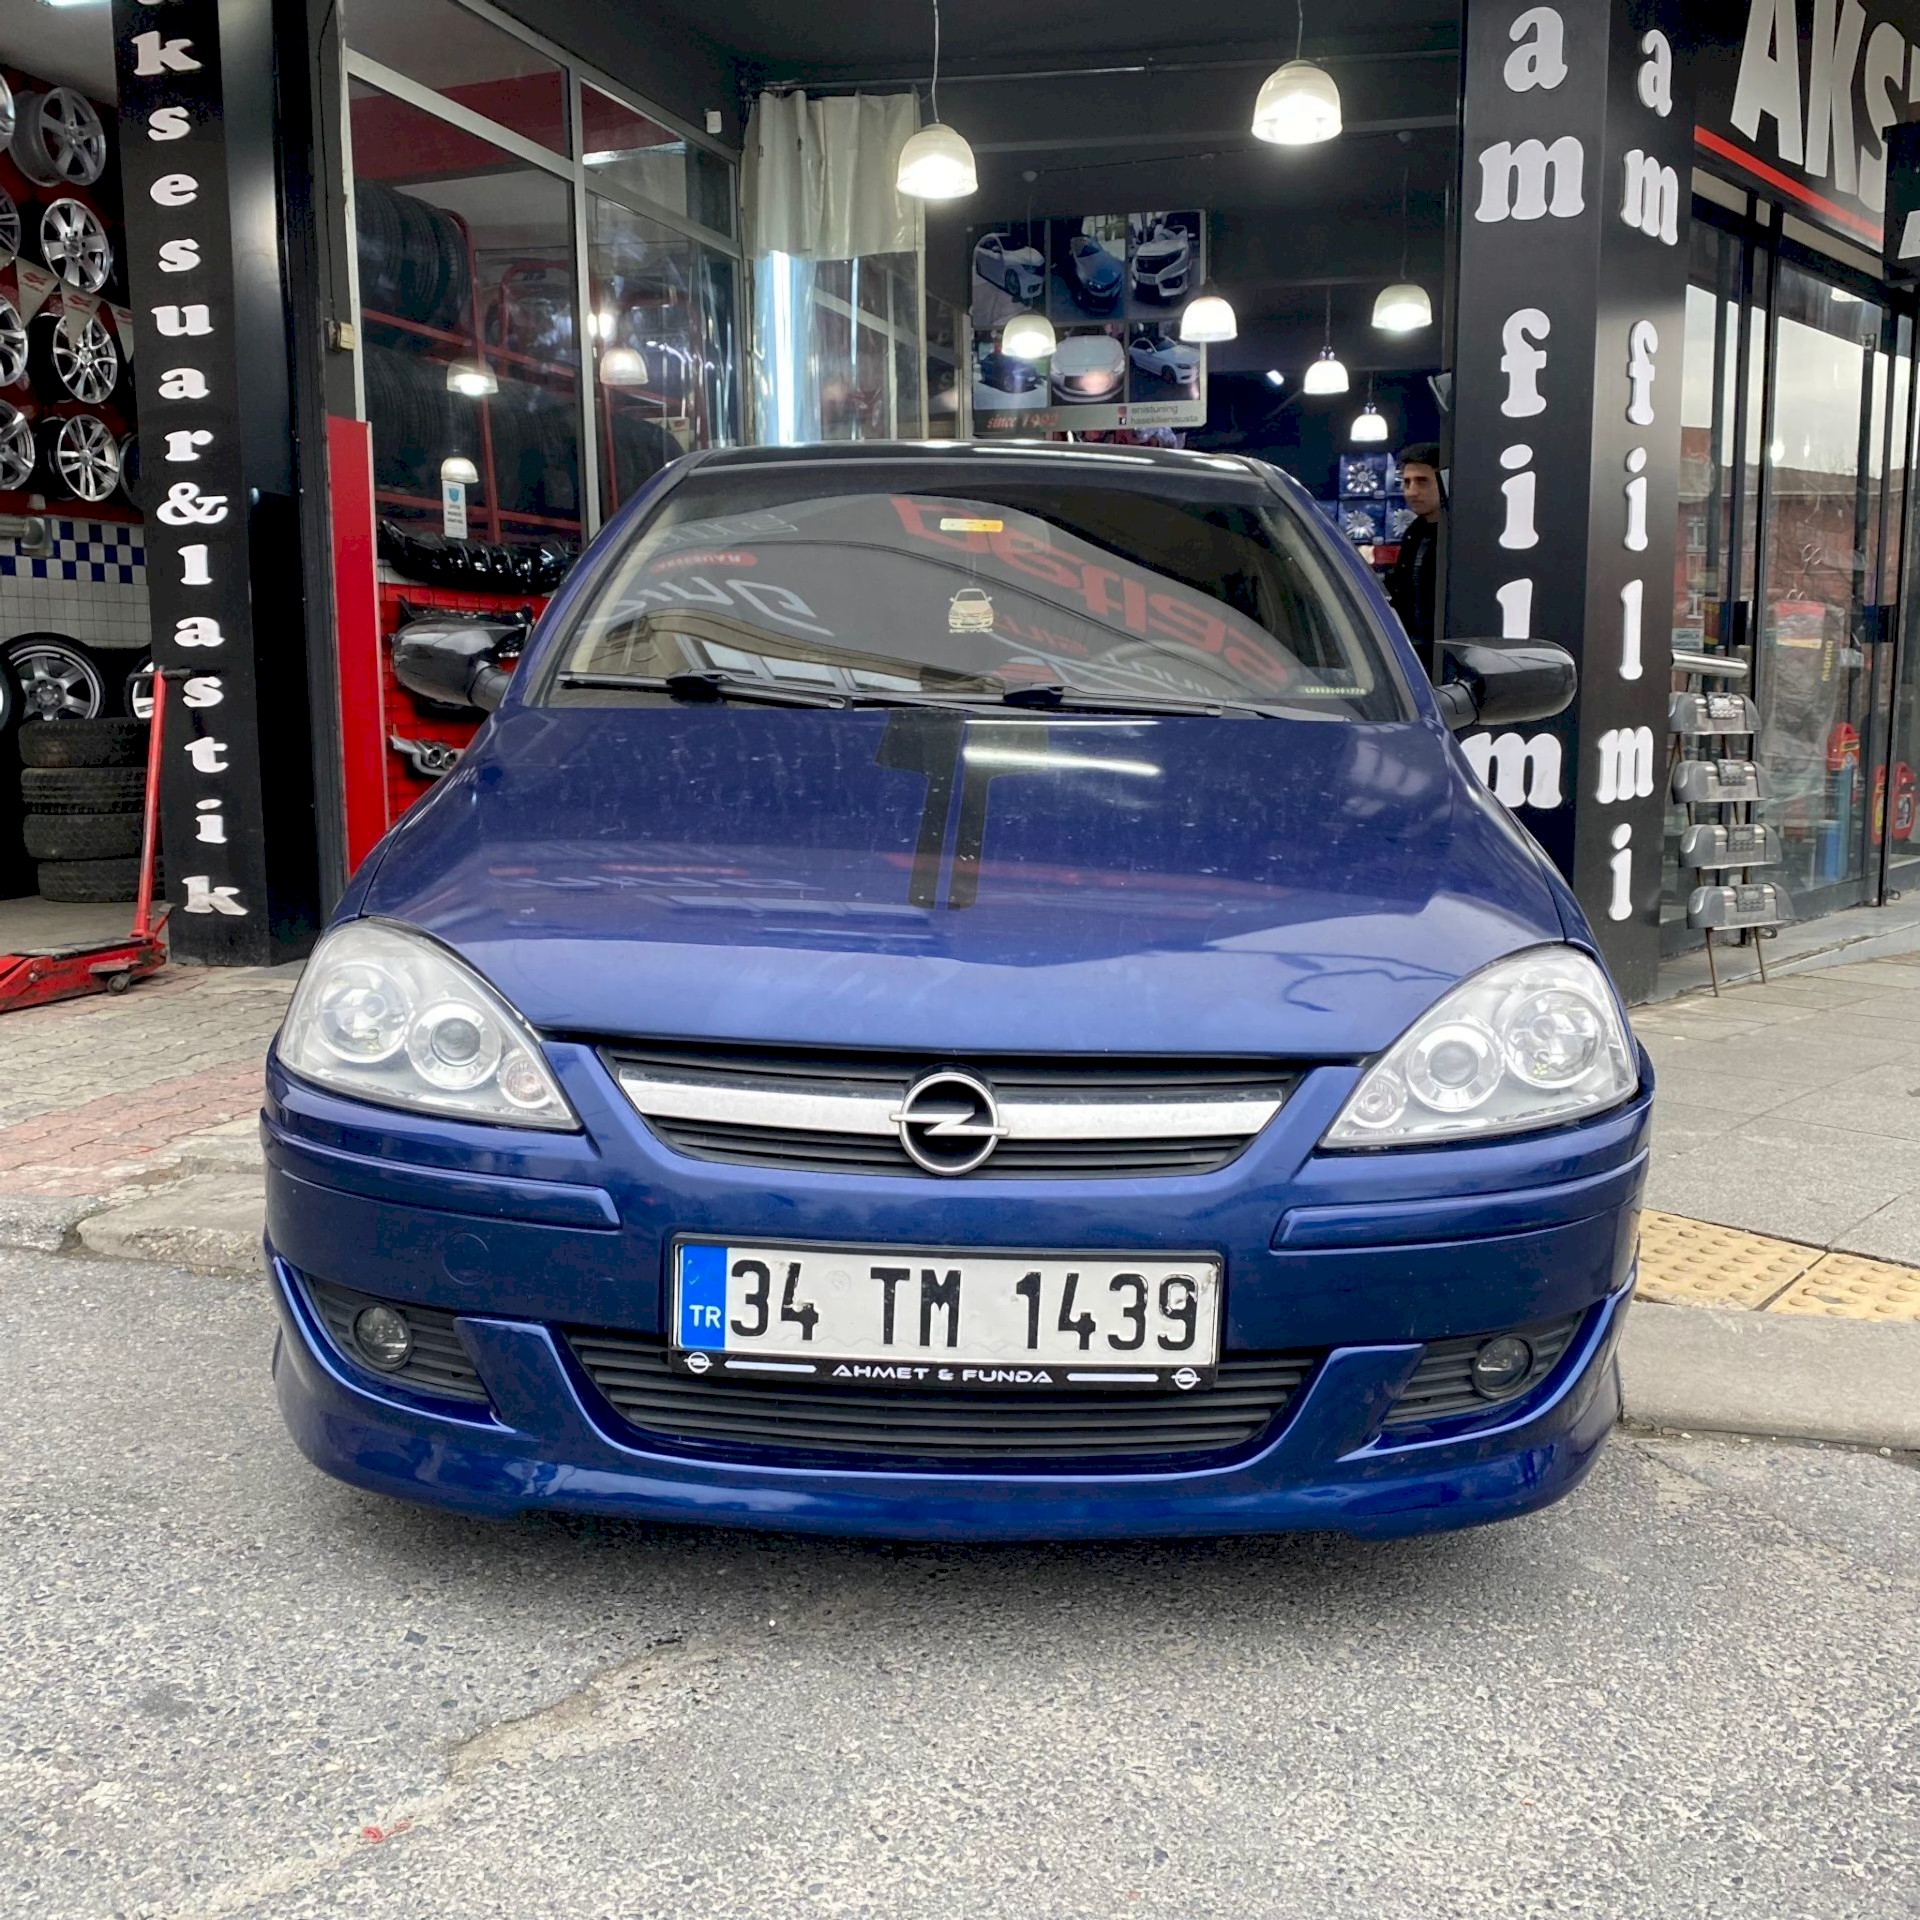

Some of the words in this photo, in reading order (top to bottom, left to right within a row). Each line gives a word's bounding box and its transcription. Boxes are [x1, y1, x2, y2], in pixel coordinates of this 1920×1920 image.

[1730, 0, 1920, 215] AKS
[987, 414, 1017, 429] since
[131, 0, 248, 917] ksesuar&lastik
[689, 1303, 722, 1330] TR
[729, 1258, 820, 1341] 34
[870, 1267, 962, 1348] TM
[1015, 1270, 1200, 1352] 1439
[832, 1364, 930, 1382] AHMET
[962, 1367, 1053, 1384] FUNDA
